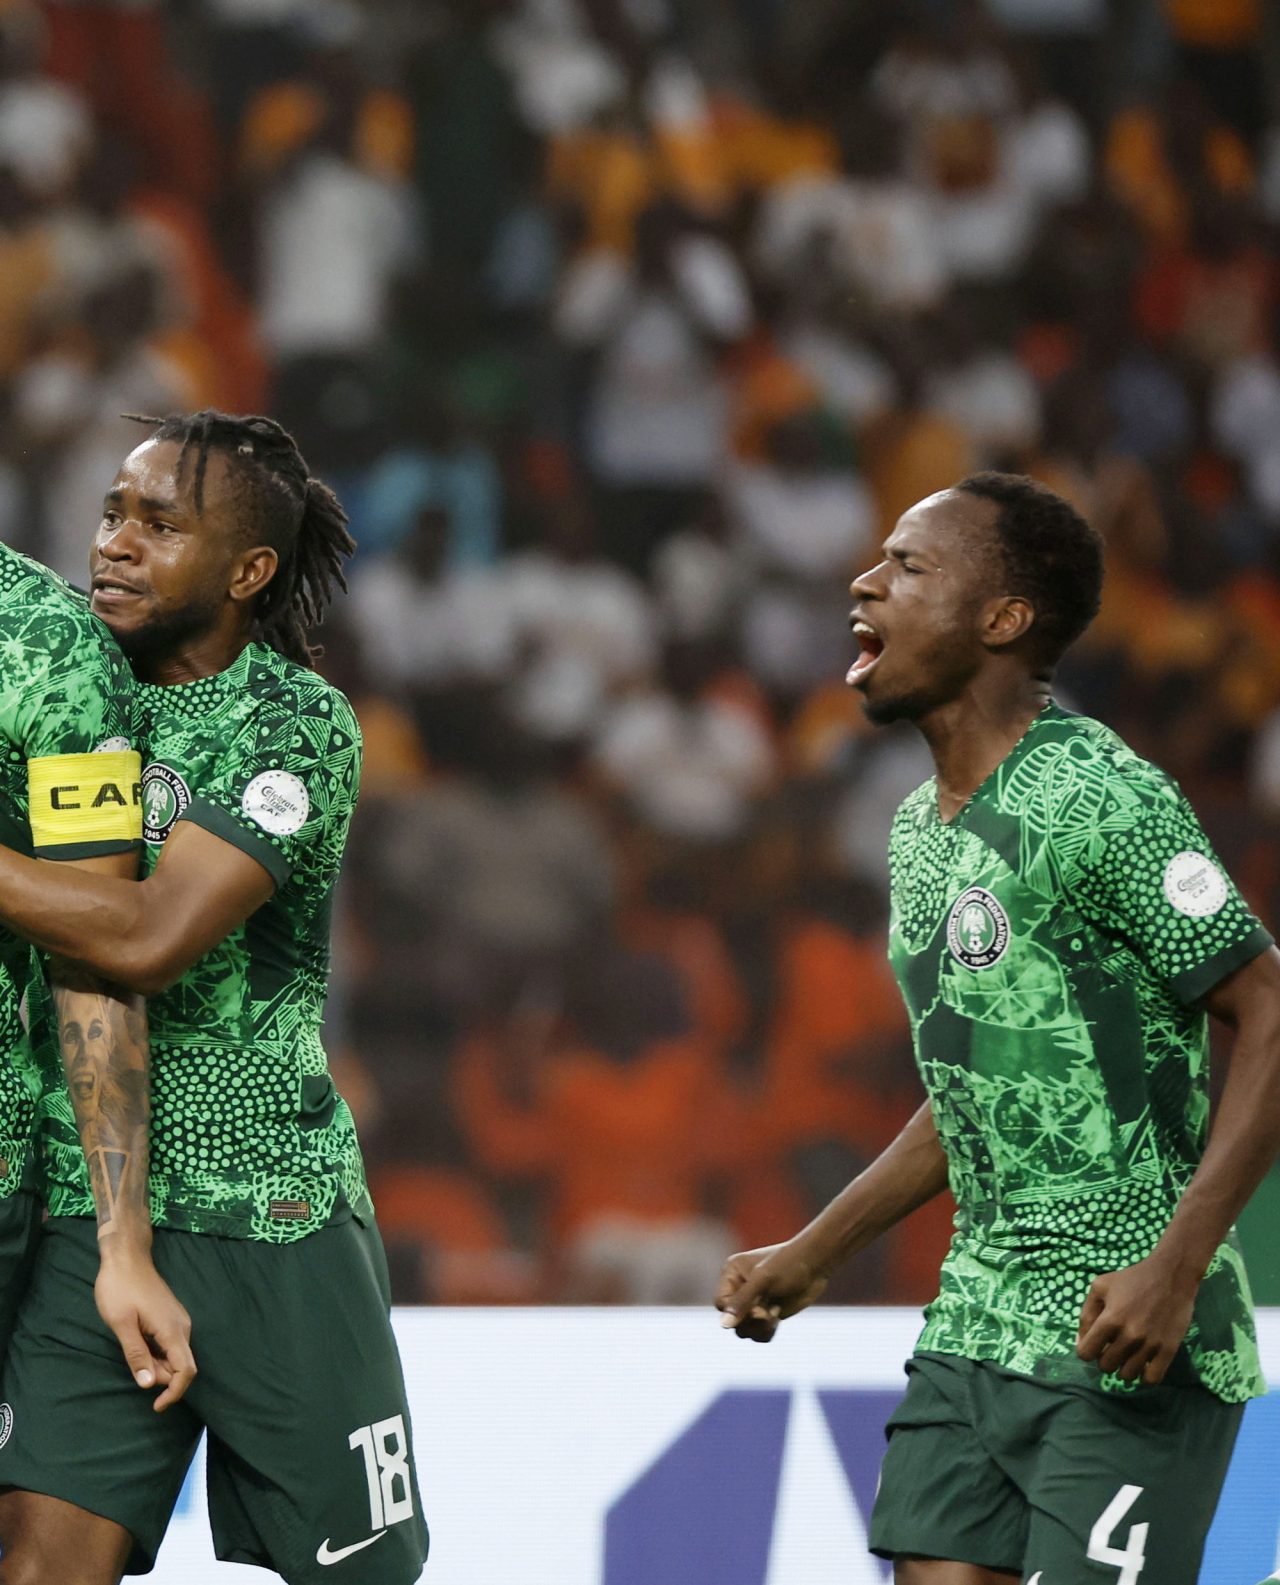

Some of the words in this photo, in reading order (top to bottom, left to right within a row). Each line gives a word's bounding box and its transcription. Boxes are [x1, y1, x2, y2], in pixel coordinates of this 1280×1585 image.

[261, 785, 298, 813] Celebrate
[144, 828, 161, 840] 1945
[348, 1414, 414, 1531] 18
[1086, 1484, 1150, 1585] 4
